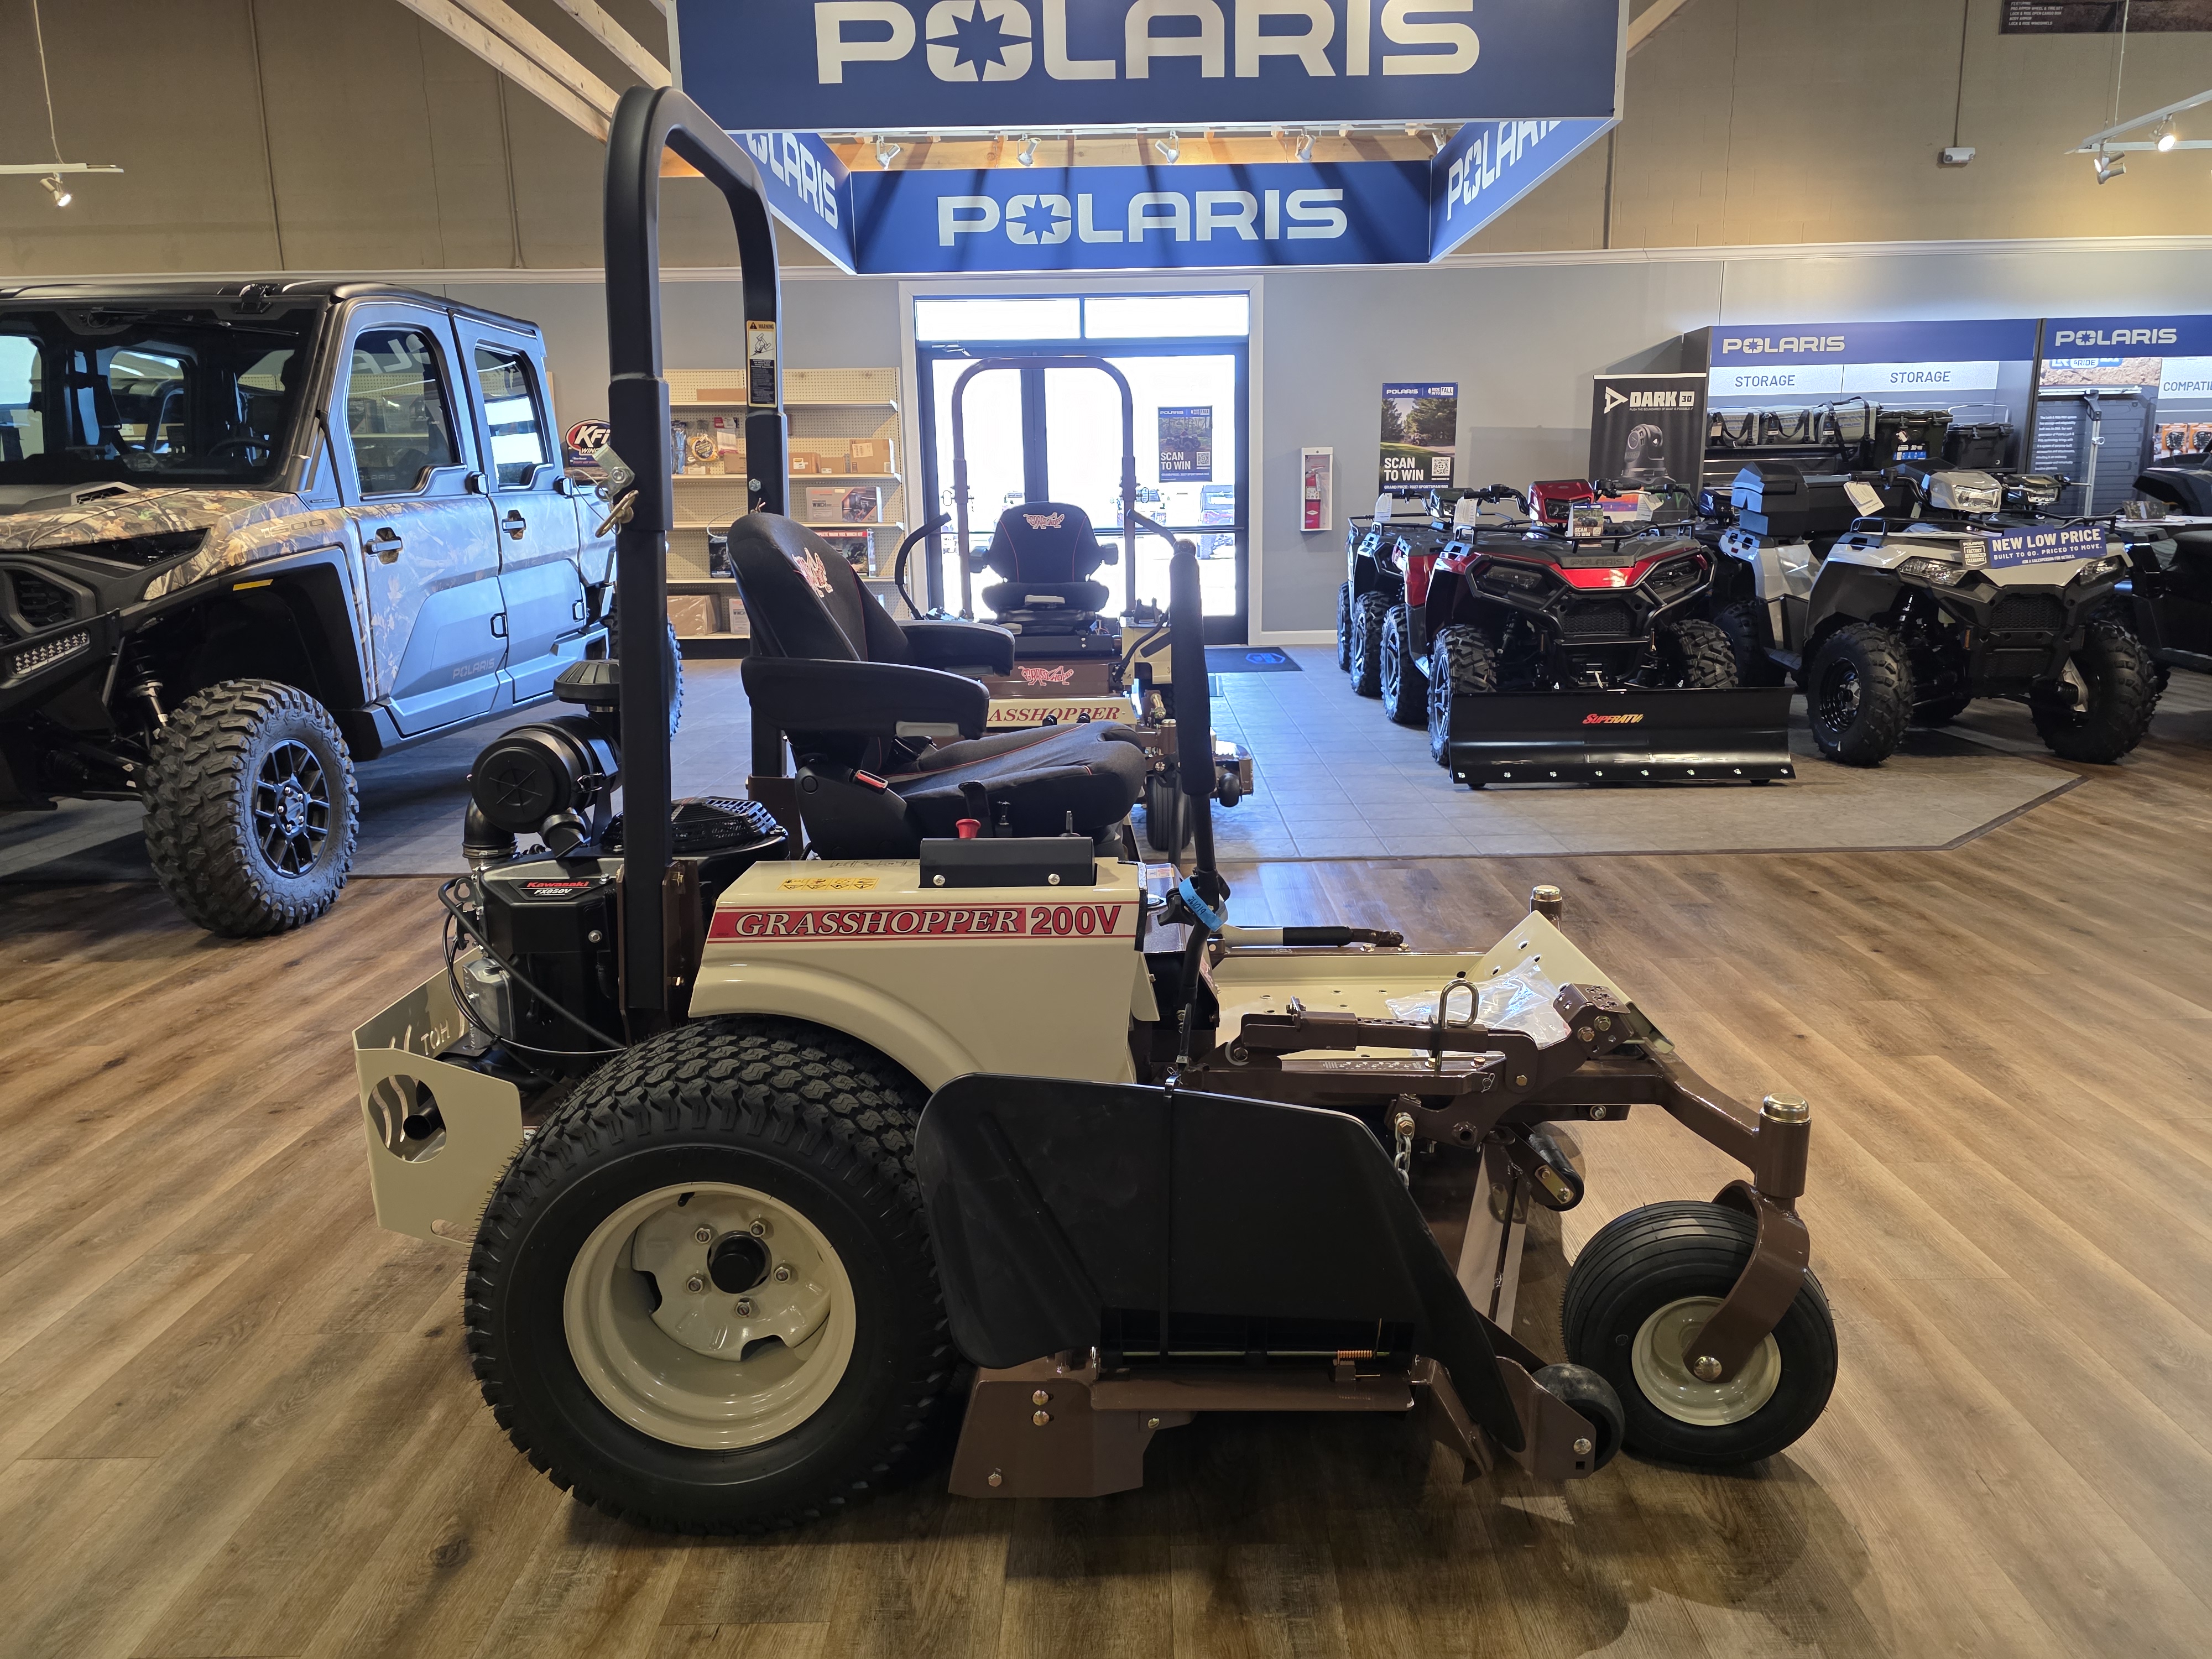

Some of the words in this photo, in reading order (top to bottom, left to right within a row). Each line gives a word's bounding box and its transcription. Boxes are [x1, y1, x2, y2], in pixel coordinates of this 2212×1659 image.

[815, 0, 1479, 84] POLARIS
[1447, 121, 1561, 221] POLAR
[747, 133, 838, 229] OLARIS
[938, 189, 1347, 246] POLARIS
[1723, 336, 1845, 353] POLARIS
[2056, 328, 2177, 346] POLARIS
[1735, 375, 1795, 387] STORAGE
[1890, 371, 1951, 383] STORAGE
[1630, 391, 1677, 407] DARK
[1161, 452, 1184, 461] SCAN
[1384, 457, 1415, 469] SCAN
[1161, 461, 1172, 470] TO
[1173, 461, 1191, 470] WIN
[1384, 469, 1399, 481] TO
[1401, 469, 1424, 481] WIN
[1992, 536, 2022, 551] NEW
[2027, 533, 2057, 548] LOW
[2060, 528, 2101, 544] PRICE
[452, 658, 495, 680] POLARIS
[988, 707, 1120, 722] ASSHOPPER
[735, 910, 1019, 936] GRASSHOPPER
[1030, 905, 1121, 935] 200V
